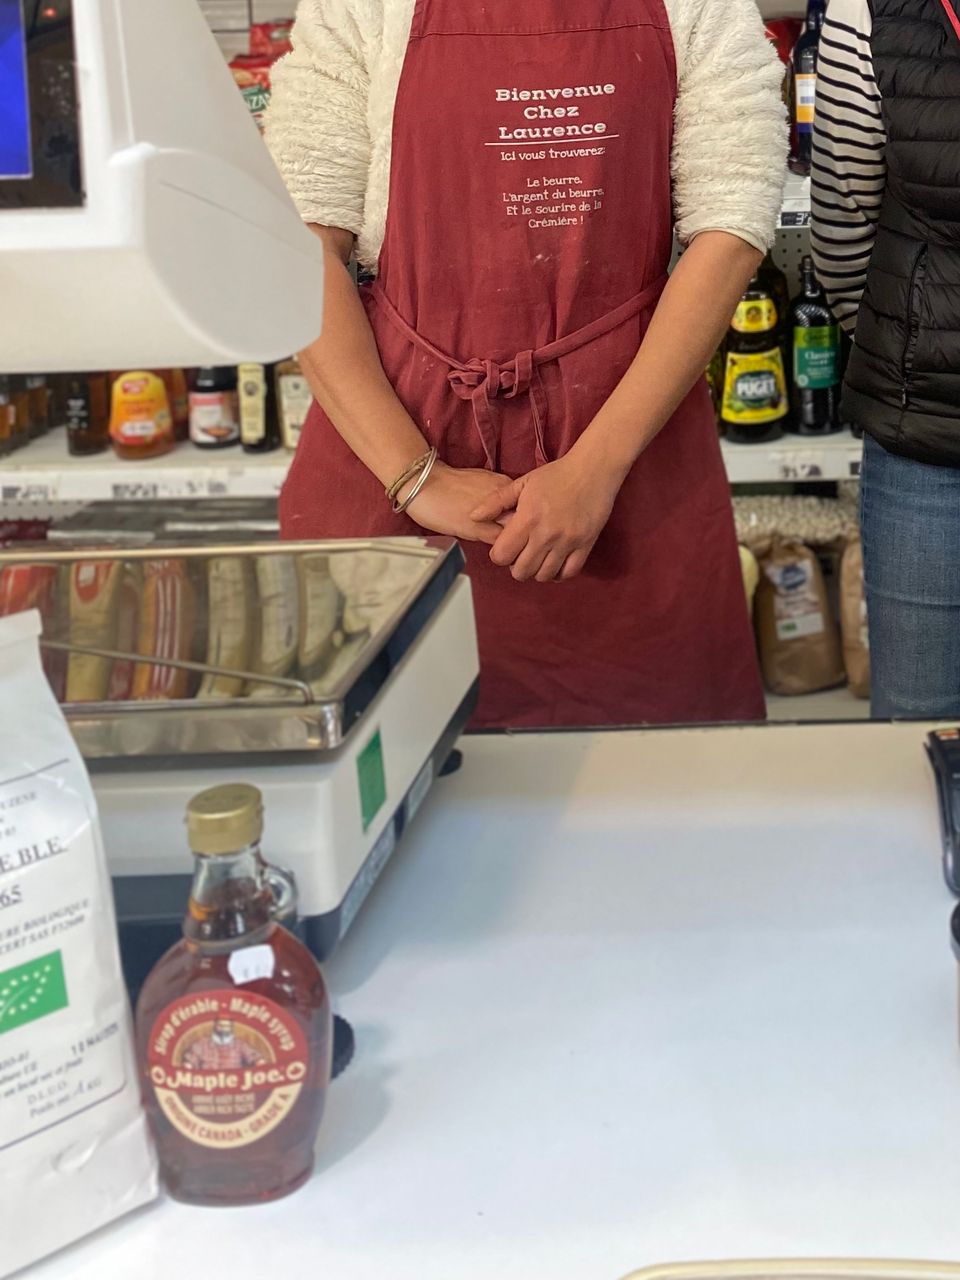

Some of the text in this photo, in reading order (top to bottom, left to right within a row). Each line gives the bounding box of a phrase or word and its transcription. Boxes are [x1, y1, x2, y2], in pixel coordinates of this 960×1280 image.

[495, 83, 616, 102] Bienvenue
[523, 105, 580, 120] Chez
[498, 122, 607, 140] Laurence
[500, 151, 516, 161] Ici
[518, 149, 546, 161] vous
[526, 177, 540, 188] Le
[502, 190, 549, 204] L'argent
[552, 189, 567, 200] du
[506, 206, 518, 216] Et
[521, 205, 532, 216] le
[535, 202, 577, 214] sourire
[578, 202, 591, 213] de
[736, 379, 776, 397] PUGET
[18, 835, 63, 867] BLE
[171, 998, 219, 1027] d'érable
[229, 998, 271, 1023] Maple
[166, 1072, 238, 1092] Maple
[199, 1126, 244, 1142] CANADA
[248, 1108, 278, 1134] GRADE
